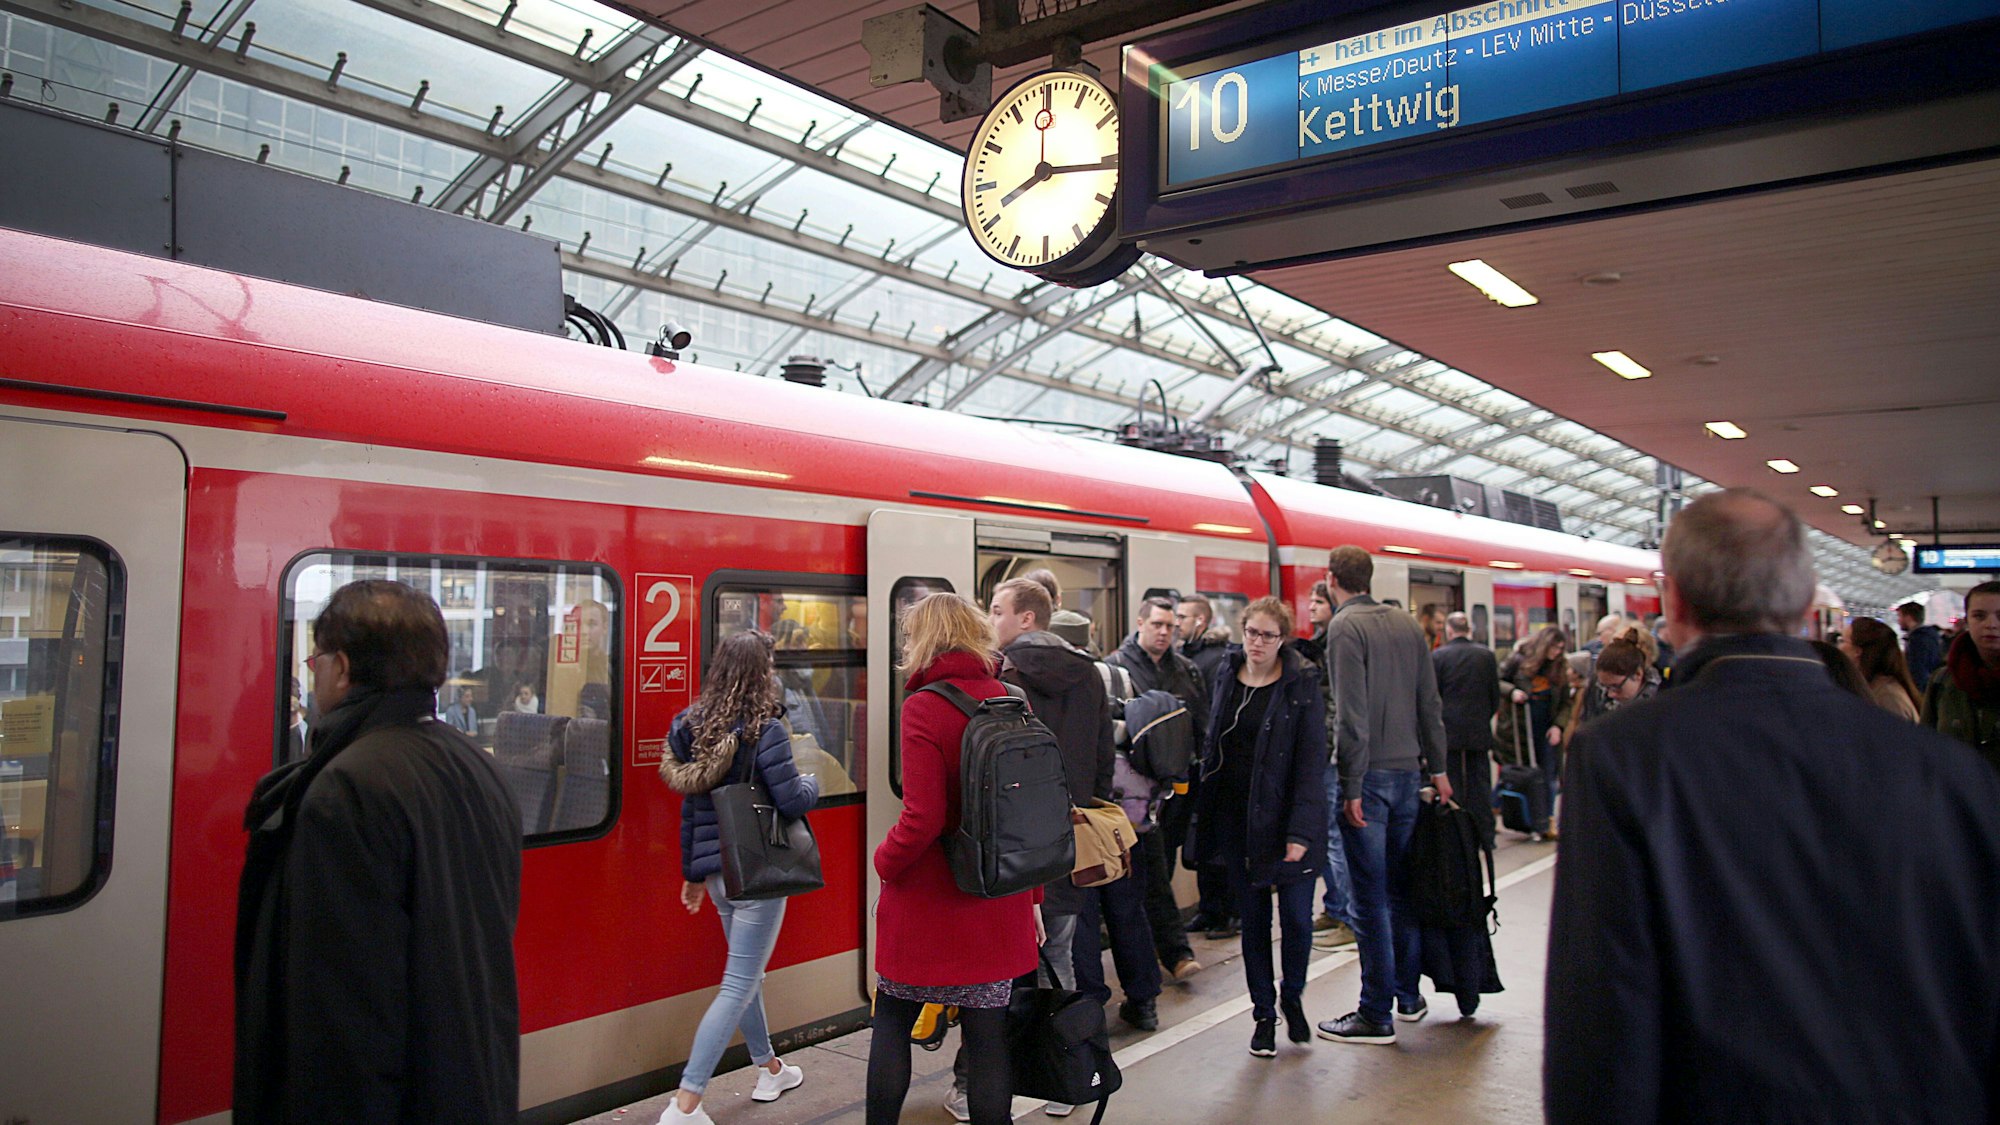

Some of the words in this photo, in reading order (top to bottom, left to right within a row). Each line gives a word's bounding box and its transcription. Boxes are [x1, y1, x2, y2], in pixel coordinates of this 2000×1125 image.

[1299, 81, 1310, 101] K
[1317, 48, 1457, 96] Messe/Deutz
[1481, 29, 1522, 59] LEV
[1530, 14, 1594, 48] Mitte
[1335, 32, 1386, 61] hält
[1394, 25, 1422, 47] im
[1175, 71, 1248, 151] 10
[1298, 82, 1460, 148] Kettwig
[643, 581, 681, 652] 2
